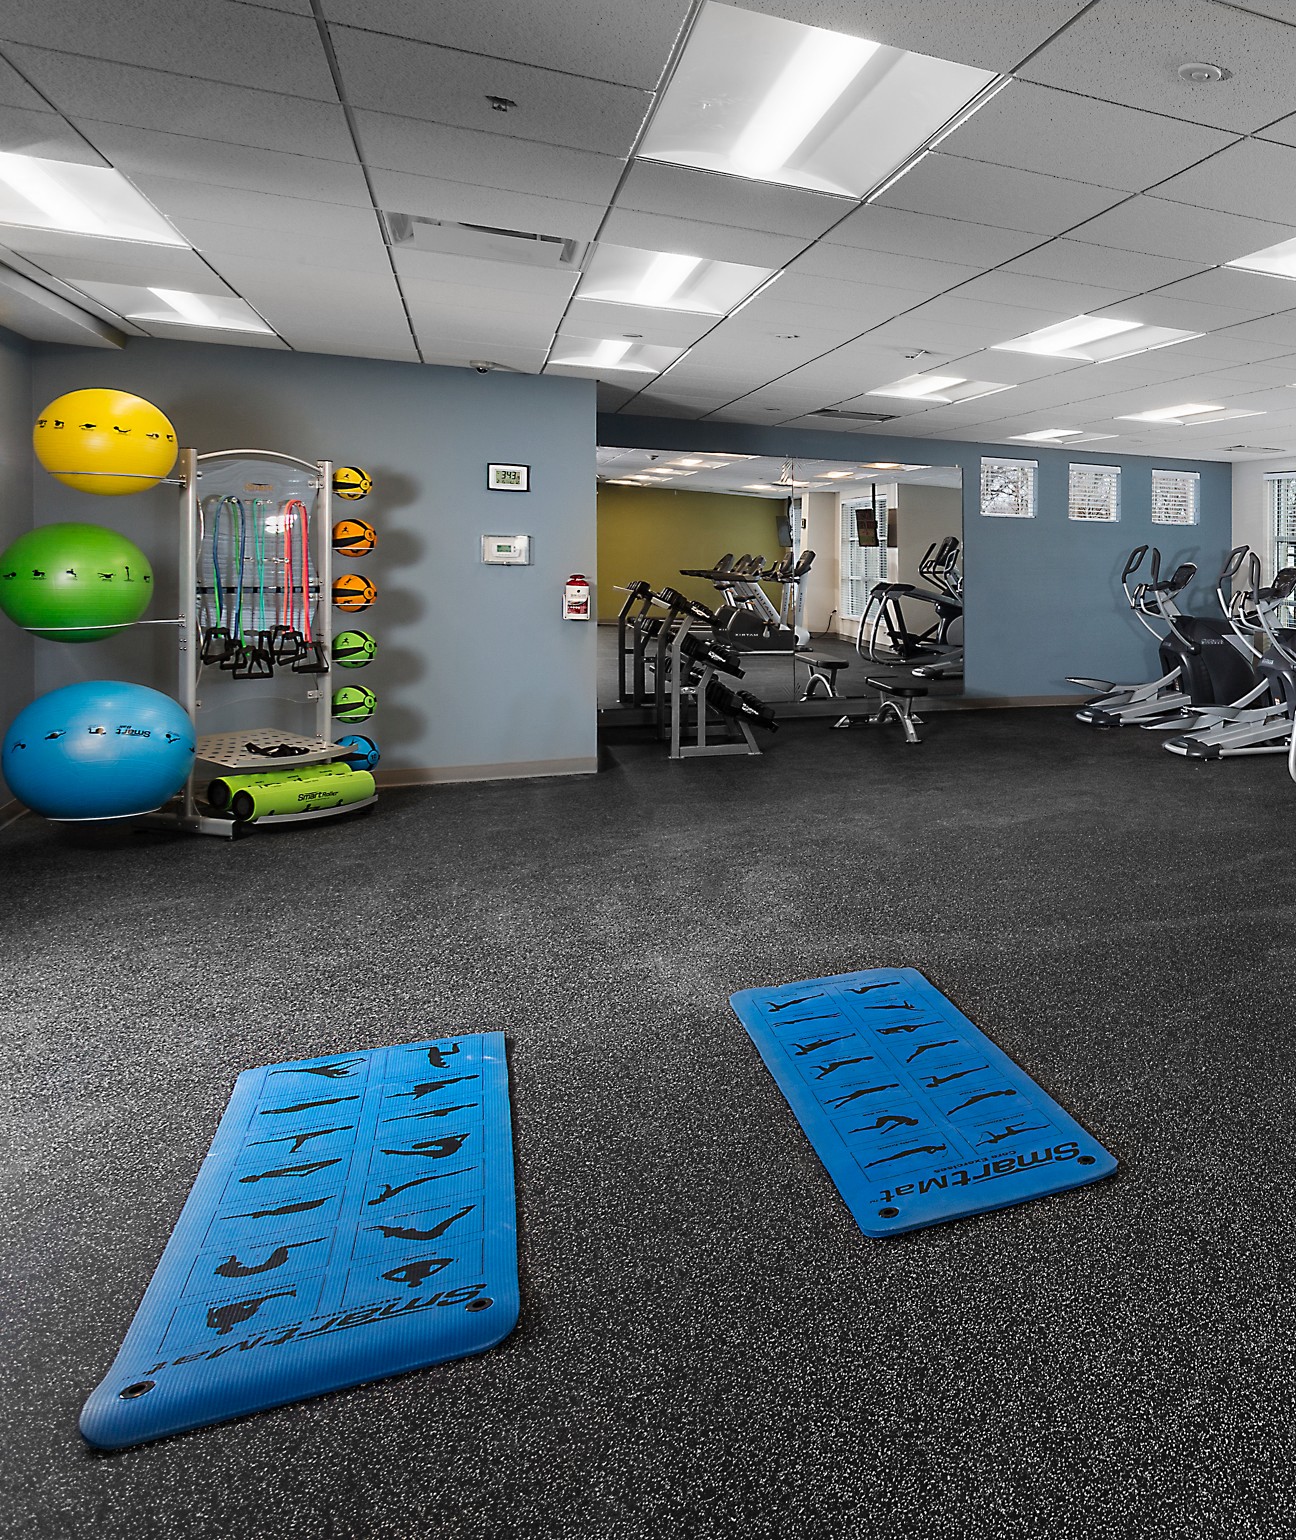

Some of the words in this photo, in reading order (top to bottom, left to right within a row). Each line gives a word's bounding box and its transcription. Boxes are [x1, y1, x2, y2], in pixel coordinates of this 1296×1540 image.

[115, 728, 151, 738] Smart
[991, 1149, 1017, 1160] Core
[879, 1141, 1081, 1203] SmartMat
[933, 1156, 989, 1174] Exercises
[142, 1283, 488, 1377] SmartMat
